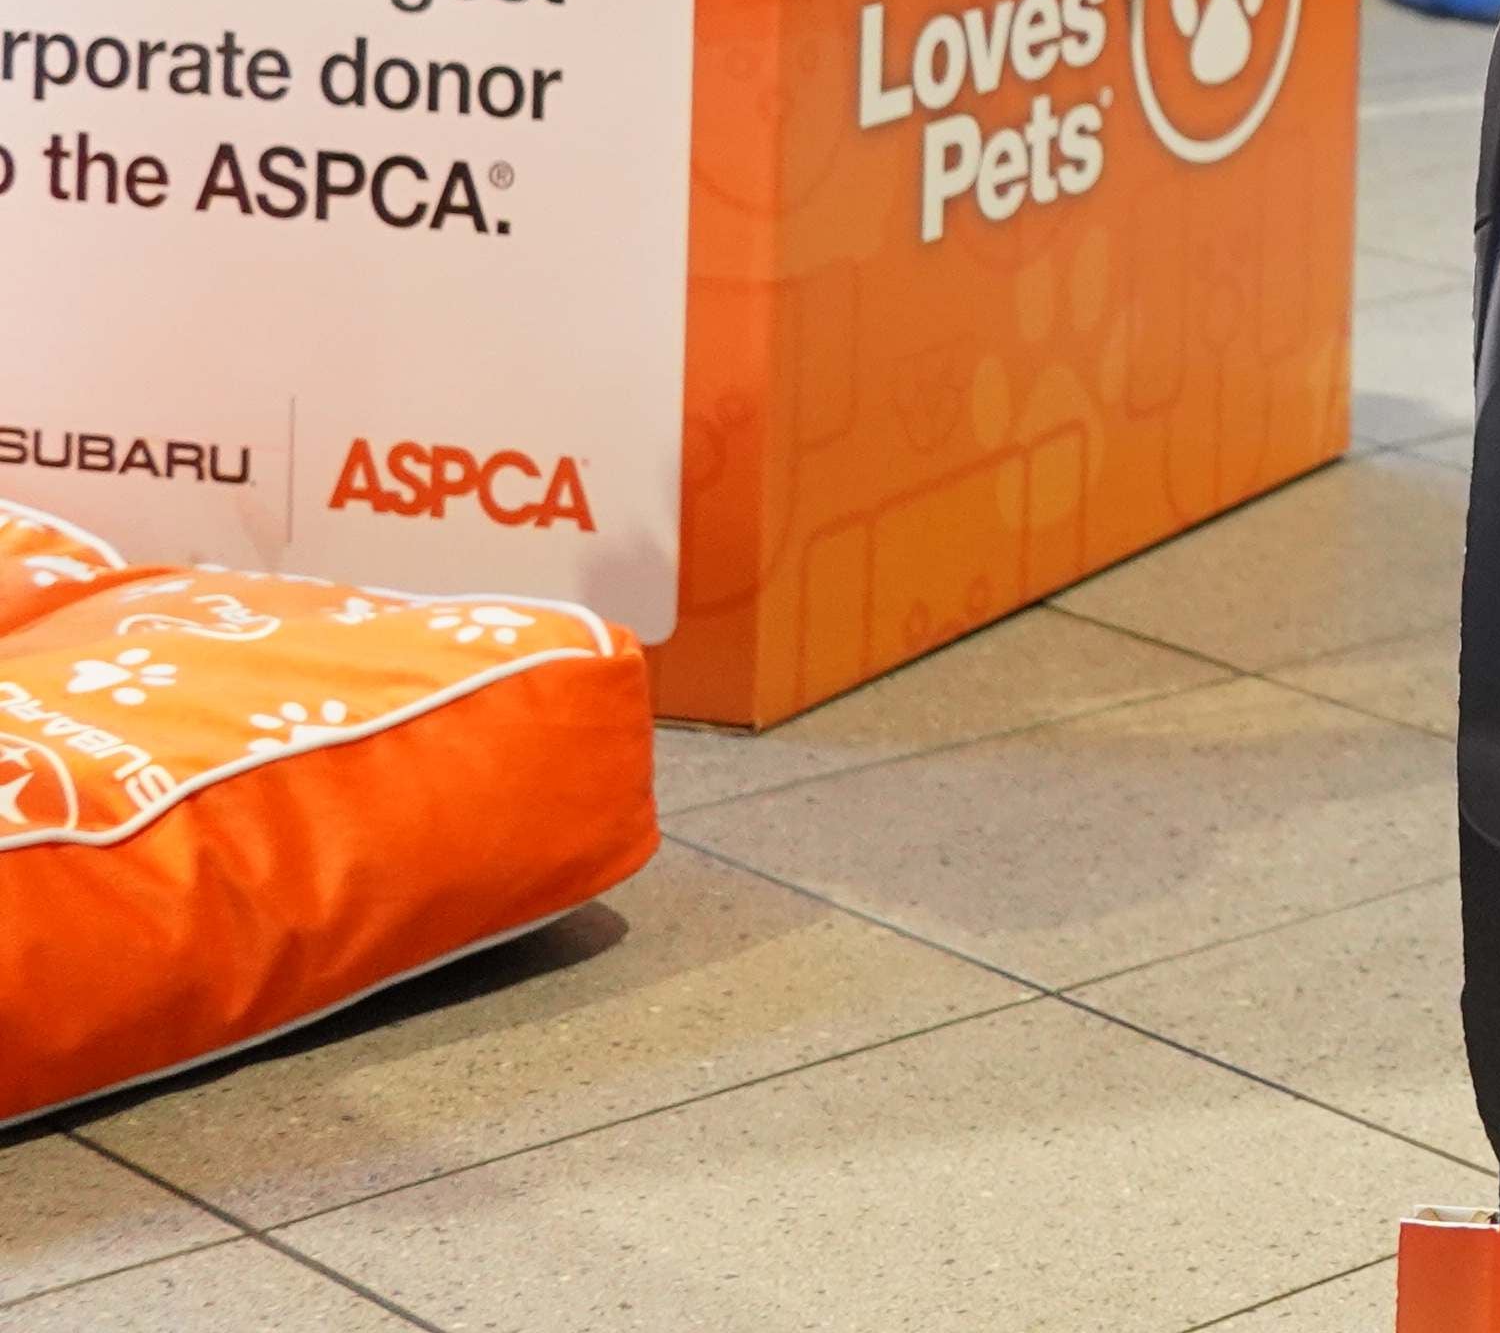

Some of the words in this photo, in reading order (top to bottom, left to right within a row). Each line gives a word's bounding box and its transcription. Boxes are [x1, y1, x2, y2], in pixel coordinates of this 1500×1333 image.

[320, 36, 564, 122] donor
[44, 133, 171, 209] the
[0, 424, 250, 485] SUBARU
[328, 437, 599, 533] ASPCA
